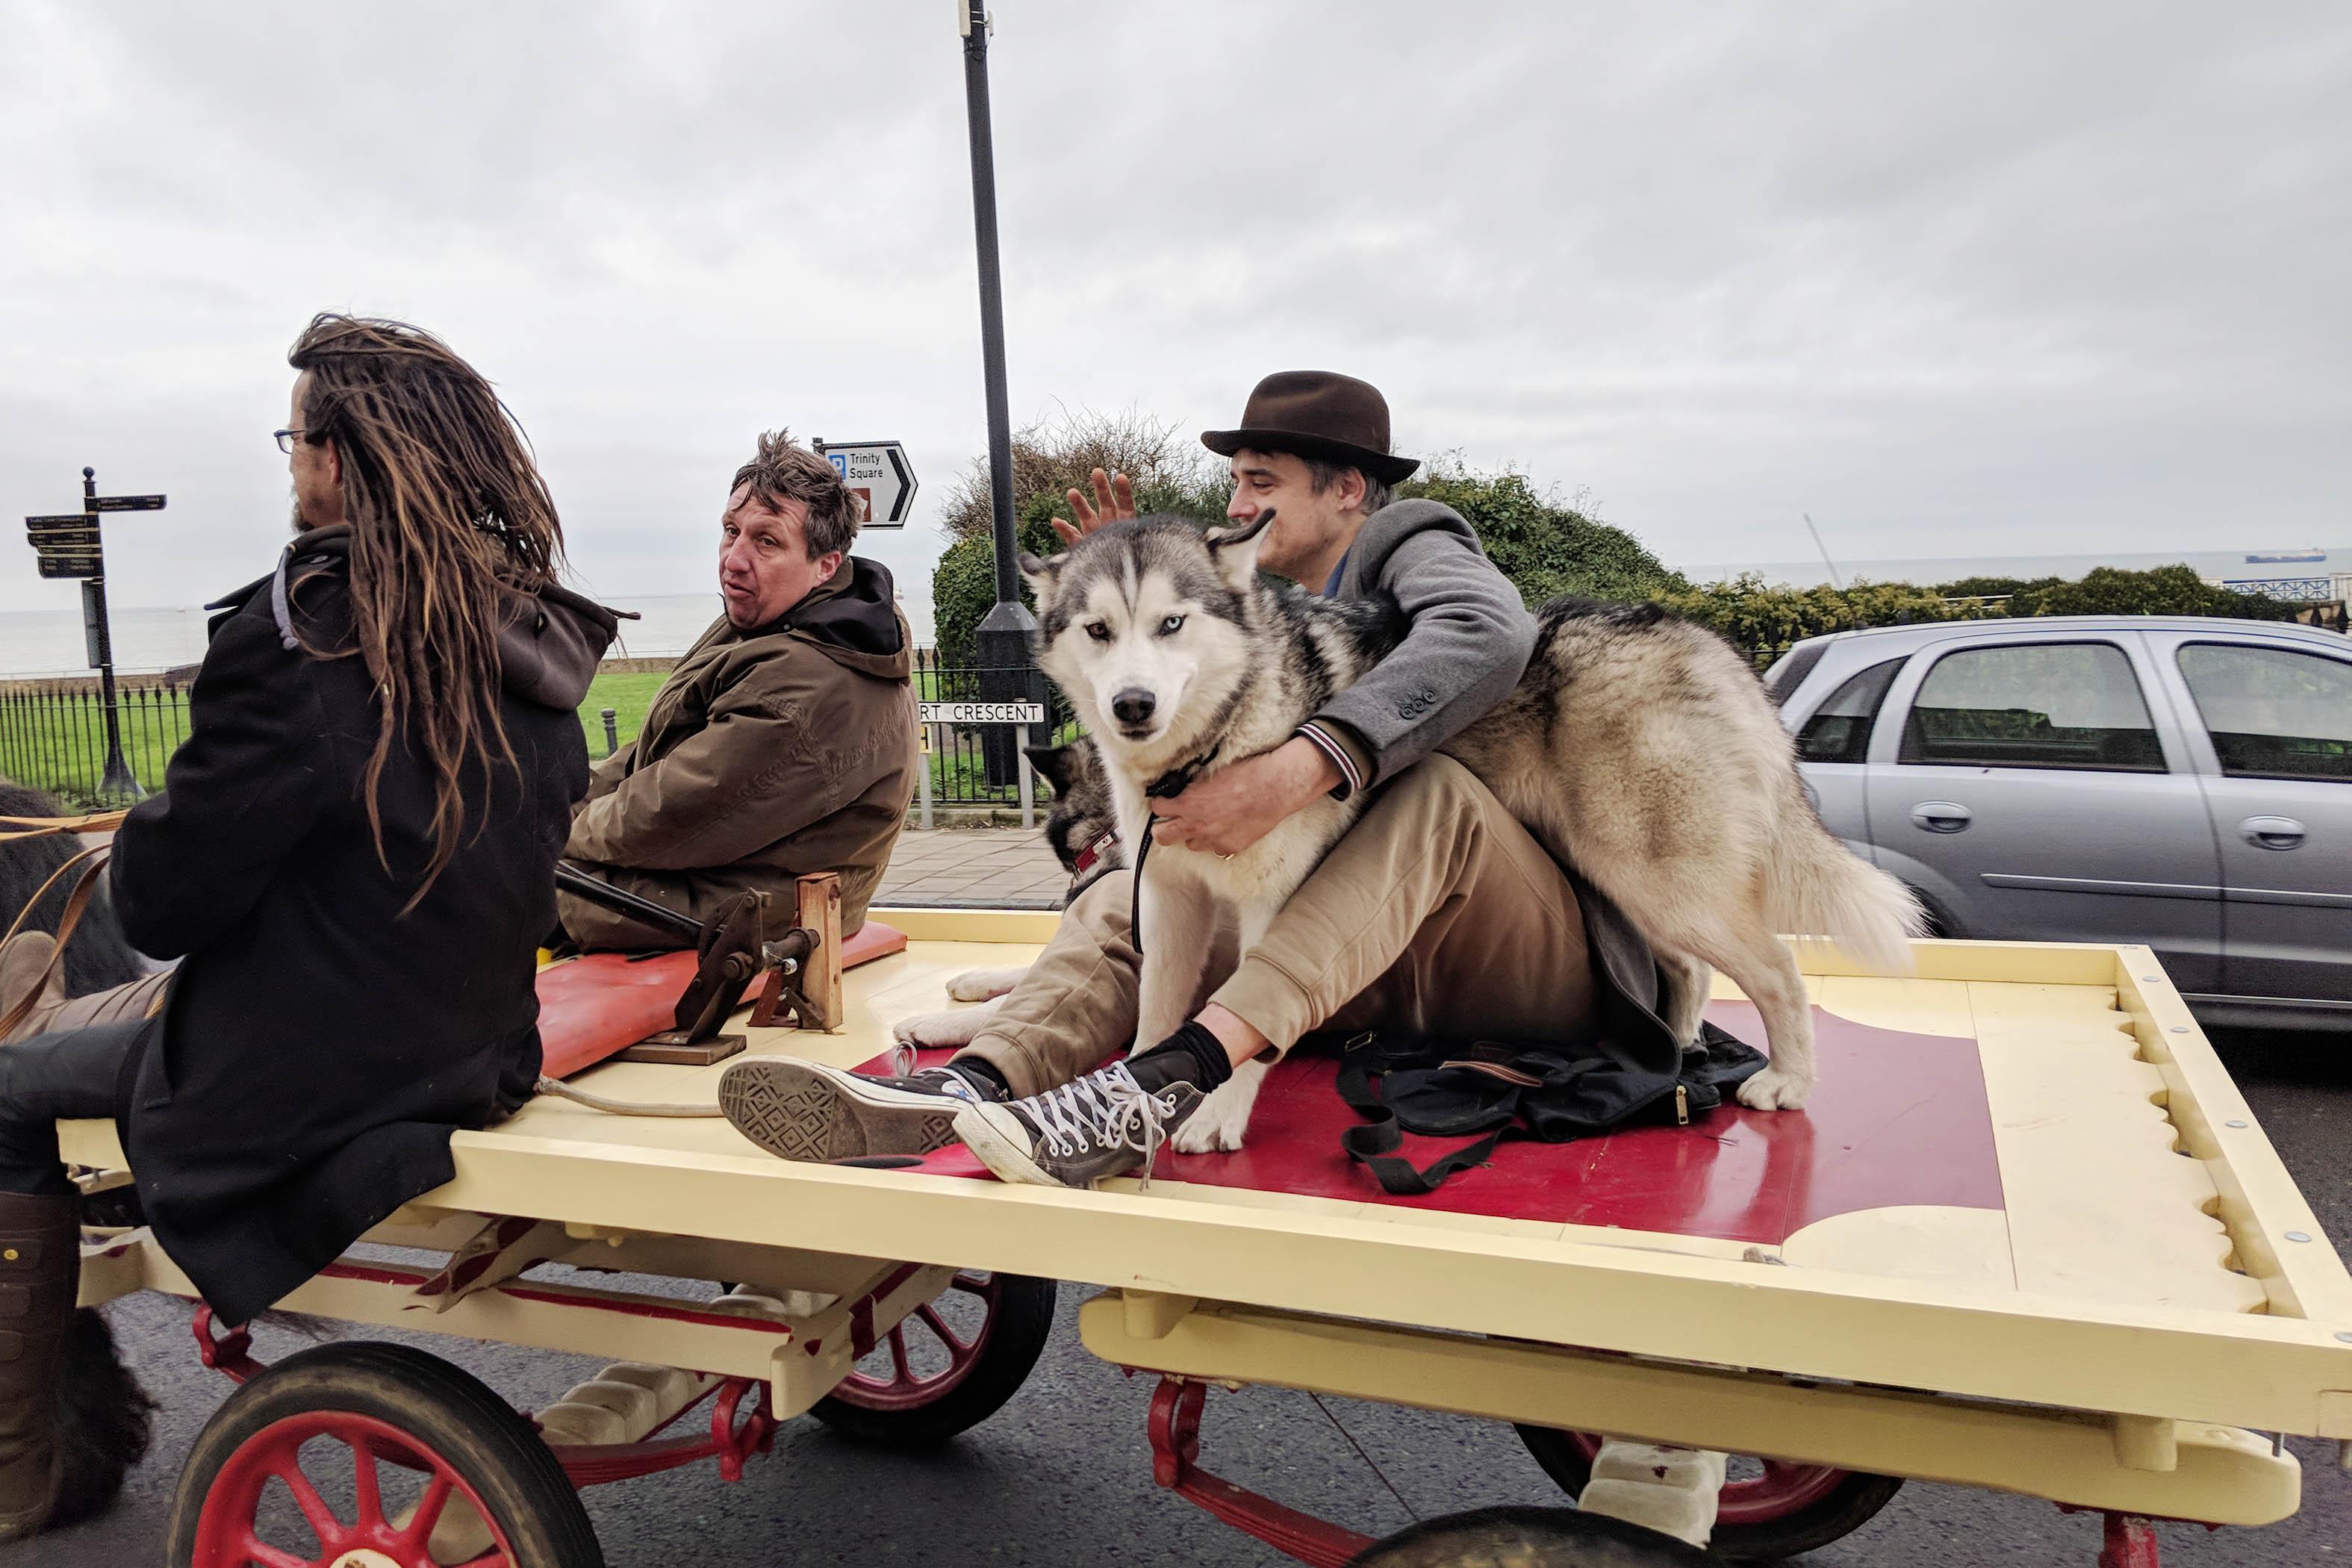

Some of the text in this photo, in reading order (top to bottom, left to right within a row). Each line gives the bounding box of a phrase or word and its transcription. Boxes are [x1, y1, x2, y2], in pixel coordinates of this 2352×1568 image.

[850, 452, 880, 465] Trinity
[850, 467, 883, 480] Square
[953, 705, 1038, 721] CRESCENT
